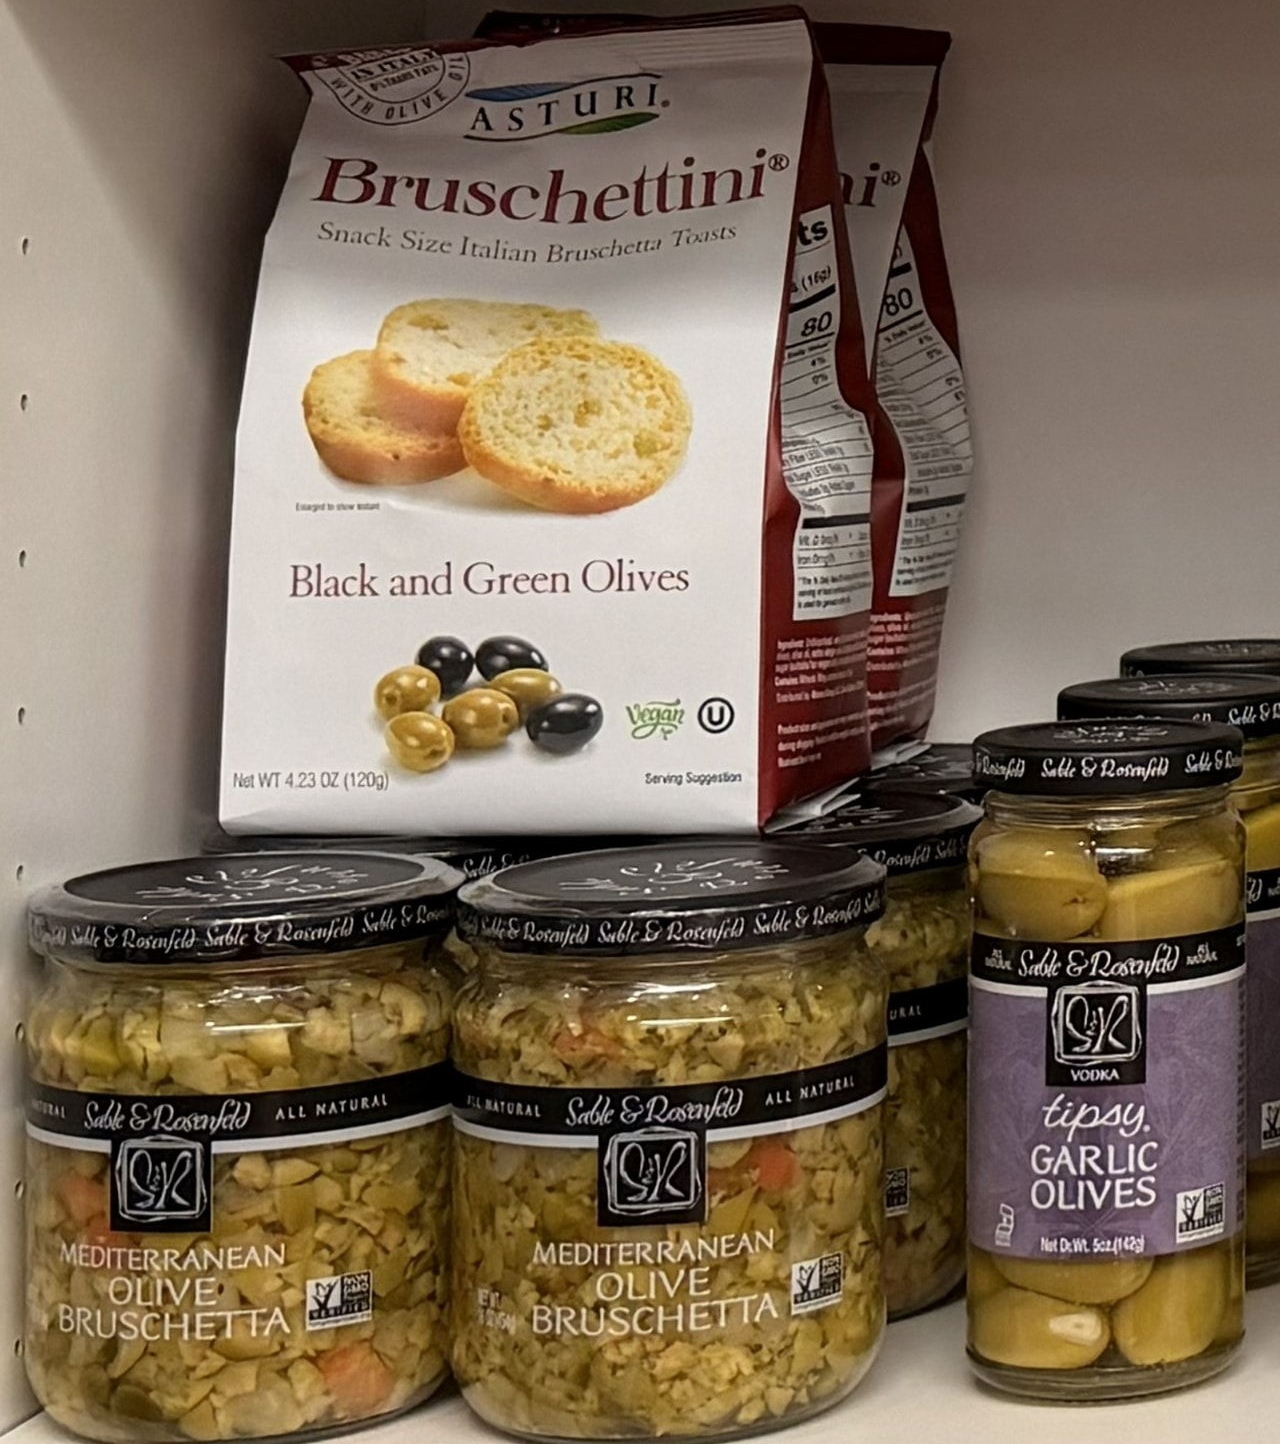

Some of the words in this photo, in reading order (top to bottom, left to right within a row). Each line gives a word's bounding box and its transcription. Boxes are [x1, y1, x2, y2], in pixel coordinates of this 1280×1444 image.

[801, 311, 833, 337] 80
[290, 562, 379, 598] Black
[389, 562, 452, 596] and
[462, 561, 571, 595] Green
[580, 560, 690, 594] Olives
[1070, 1068, 1120, 1082] VODKA
[275, 1105, 307, 1121] ALL
[316, 1096, 389, 1116] NATURAL
[566, 1094, 614, 1128] Sable
[619, 1094, 645, 1122] &
[646, 1088, 744, 1126] Rosenfeld
[1030, 1142, 1159, 1176] GARLIC
[1030, 1176, 1158, 1211] OLIVES
[60, 1242, 286, 1271] MEDITERRANEAN
[532, 1229, 775, 1268] MEDITERRANEAN
[108, 1277, 217, 1307] OLIVE
[595, 1267, 711, 1302] OLIVE
[59, 1305, 290, 1341] BRUSCHETTA
[532, 1292, 778, 1337] BRUSCHETTA
